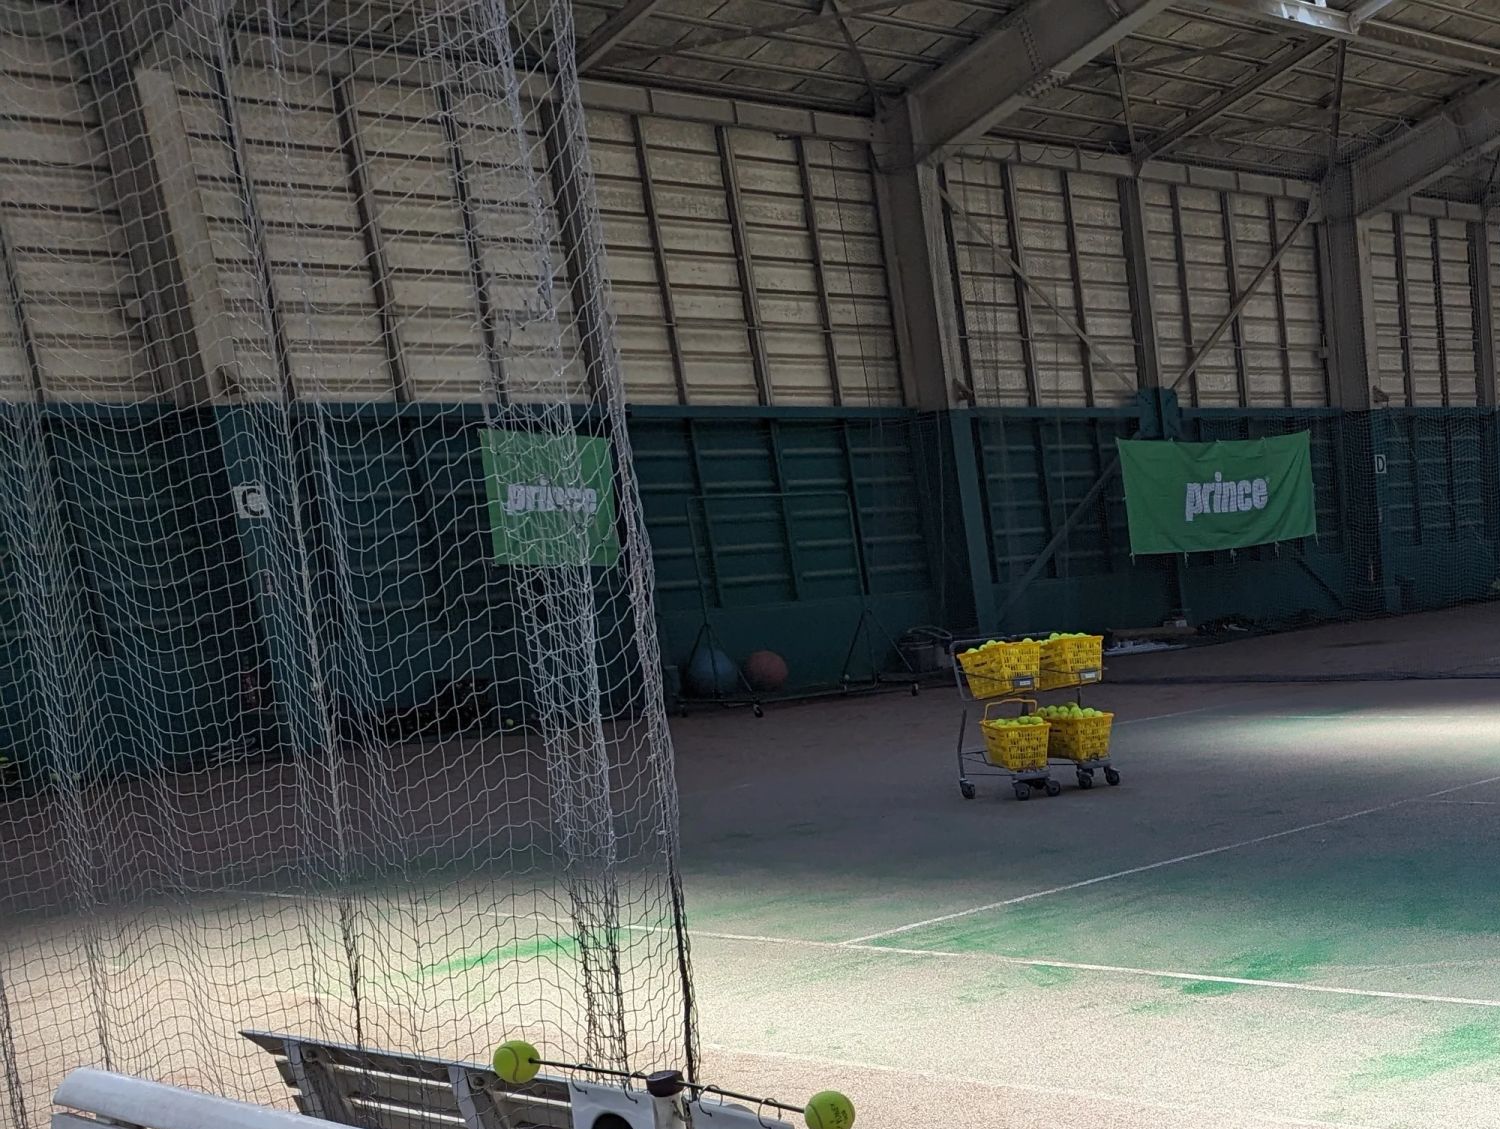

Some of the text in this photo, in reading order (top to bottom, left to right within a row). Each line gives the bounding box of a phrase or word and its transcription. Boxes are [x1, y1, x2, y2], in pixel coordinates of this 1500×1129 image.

[1377, 456, 1385, 473] D
[241, 487, 265, 517] C
[1185, 471, 1269, 522] prince
